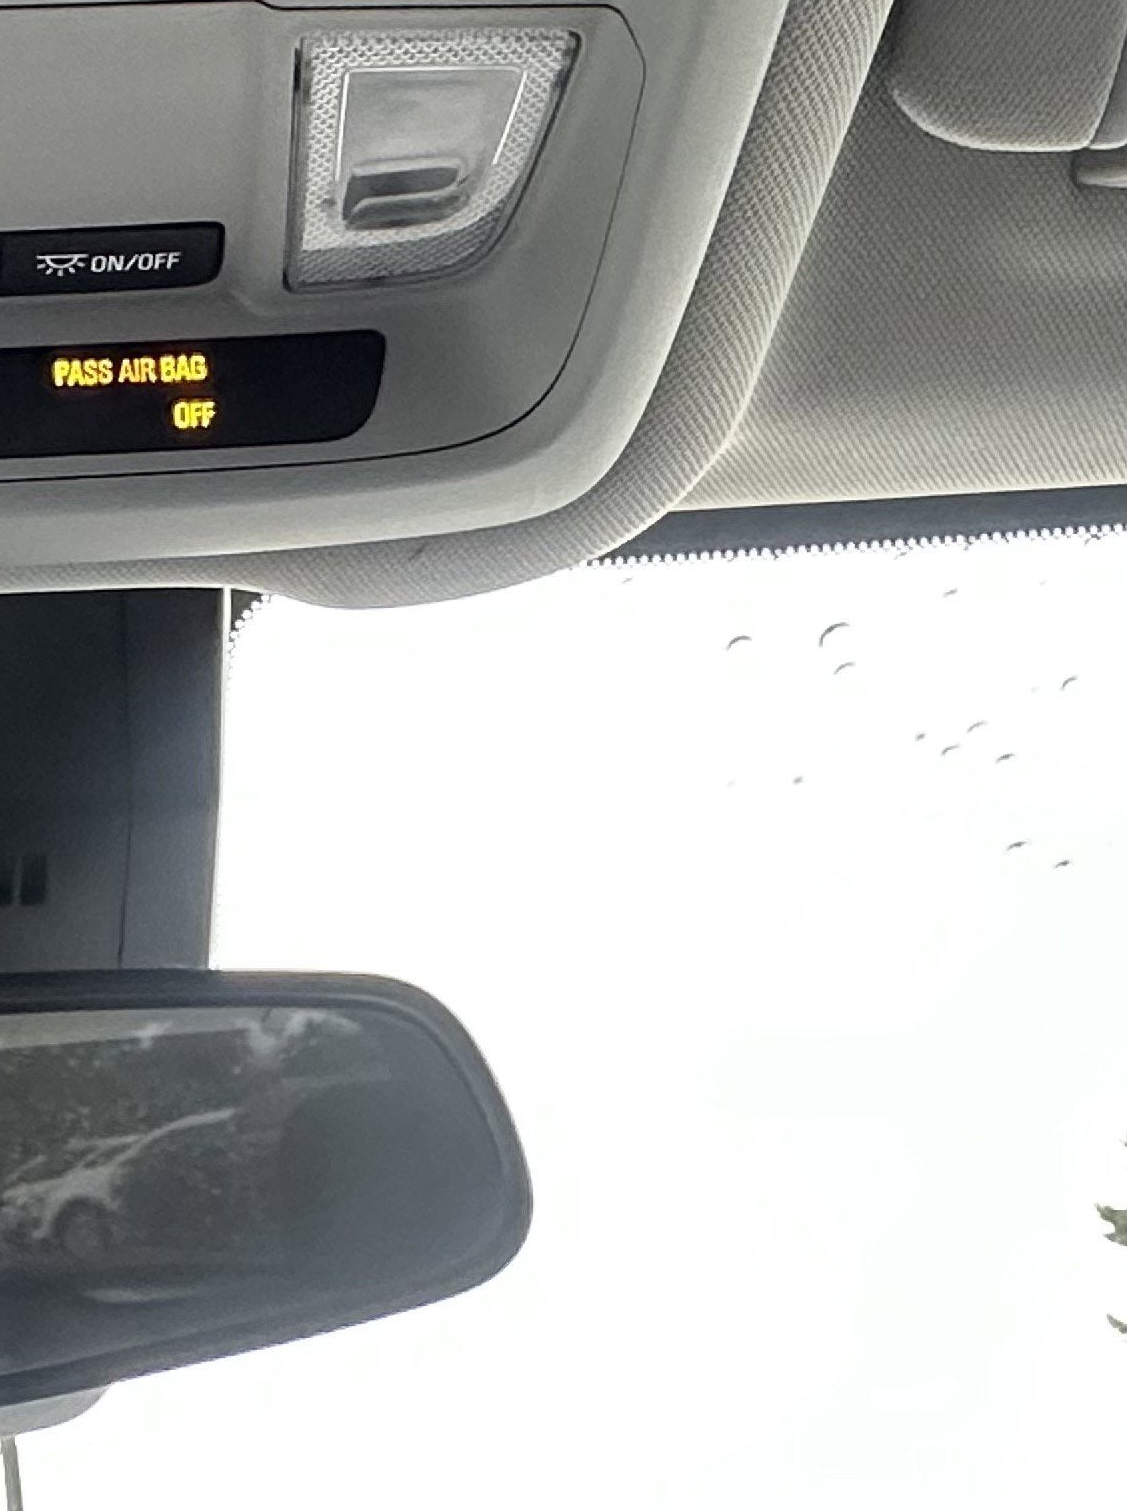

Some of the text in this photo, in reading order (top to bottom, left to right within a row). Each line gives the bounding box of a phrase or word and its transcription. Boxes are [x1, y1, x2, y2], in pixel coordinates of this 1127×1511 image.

[90, 251, 181, 273] ON/OFF
[53, 353, 208, 387] PASS AIR BAG
[173, 400, 217, 429] OFF
